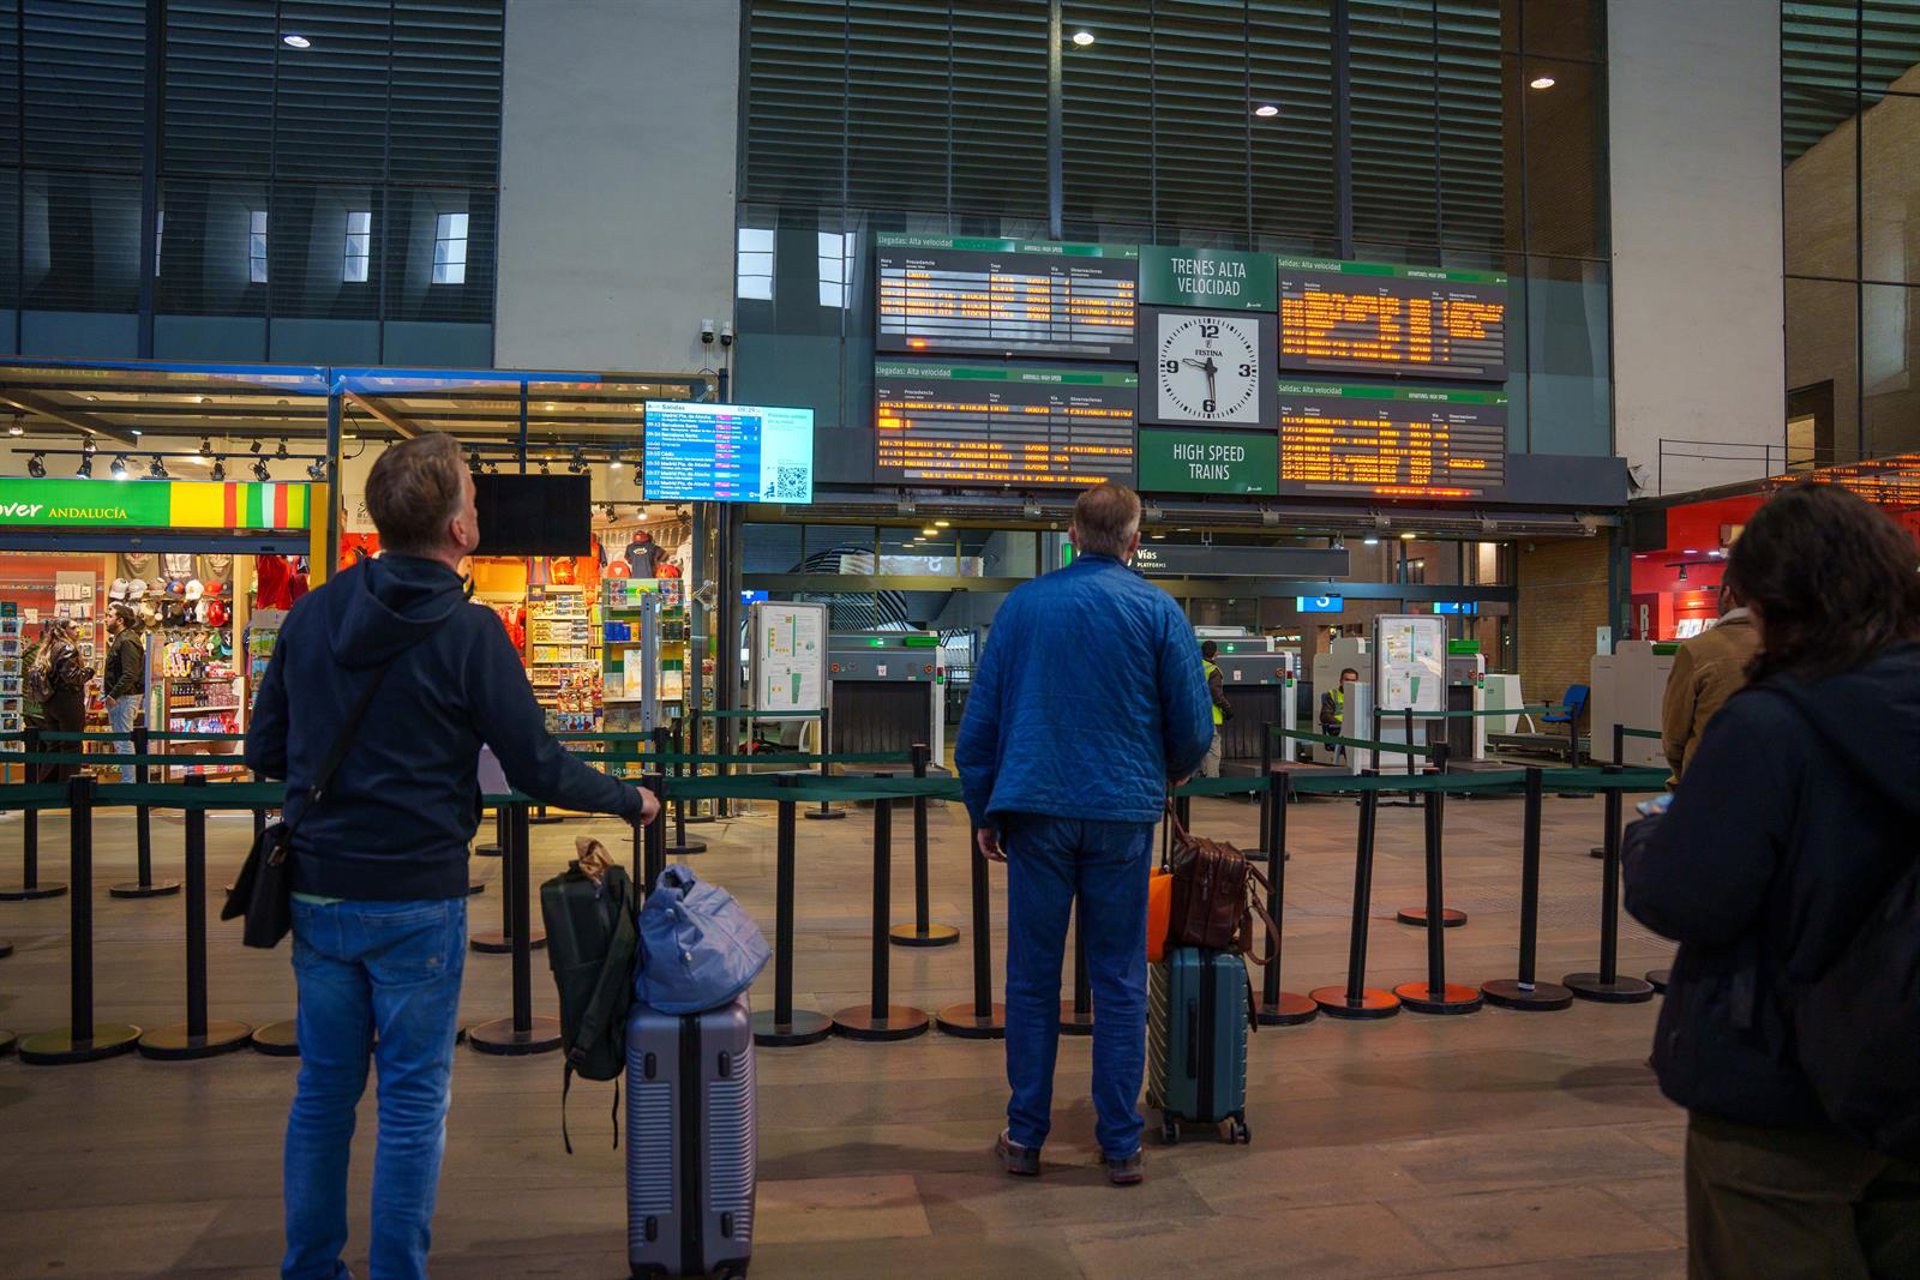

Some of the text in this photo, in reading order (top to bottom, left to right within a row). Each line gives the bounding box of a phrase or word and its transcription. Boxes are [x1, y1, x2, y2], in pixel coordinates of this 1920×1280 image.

[1171, 258, 1246, 278] TRENES ALTA
[1178, 277, 1241, 296] VELOCIDAD
[1199, 325, 1219, 339] 12
[1195, 349, 1223, 357] FESTINA
[907, 367, 920, 376] Alta
[921, 368, 952, 377] velocidad
[1166, 360, 1179, 374] 9
[1238, 364, 1251, 378] 3
[1203, 399, 1216, 413] 6
[1174, 444, 1245, 462] HIGH SPEED
[1189, 463, 1230, 480] TRAINS
[48, 507, 127, 519] ANDALUCÍA
[1137, 549, 1158, 560] Vías
